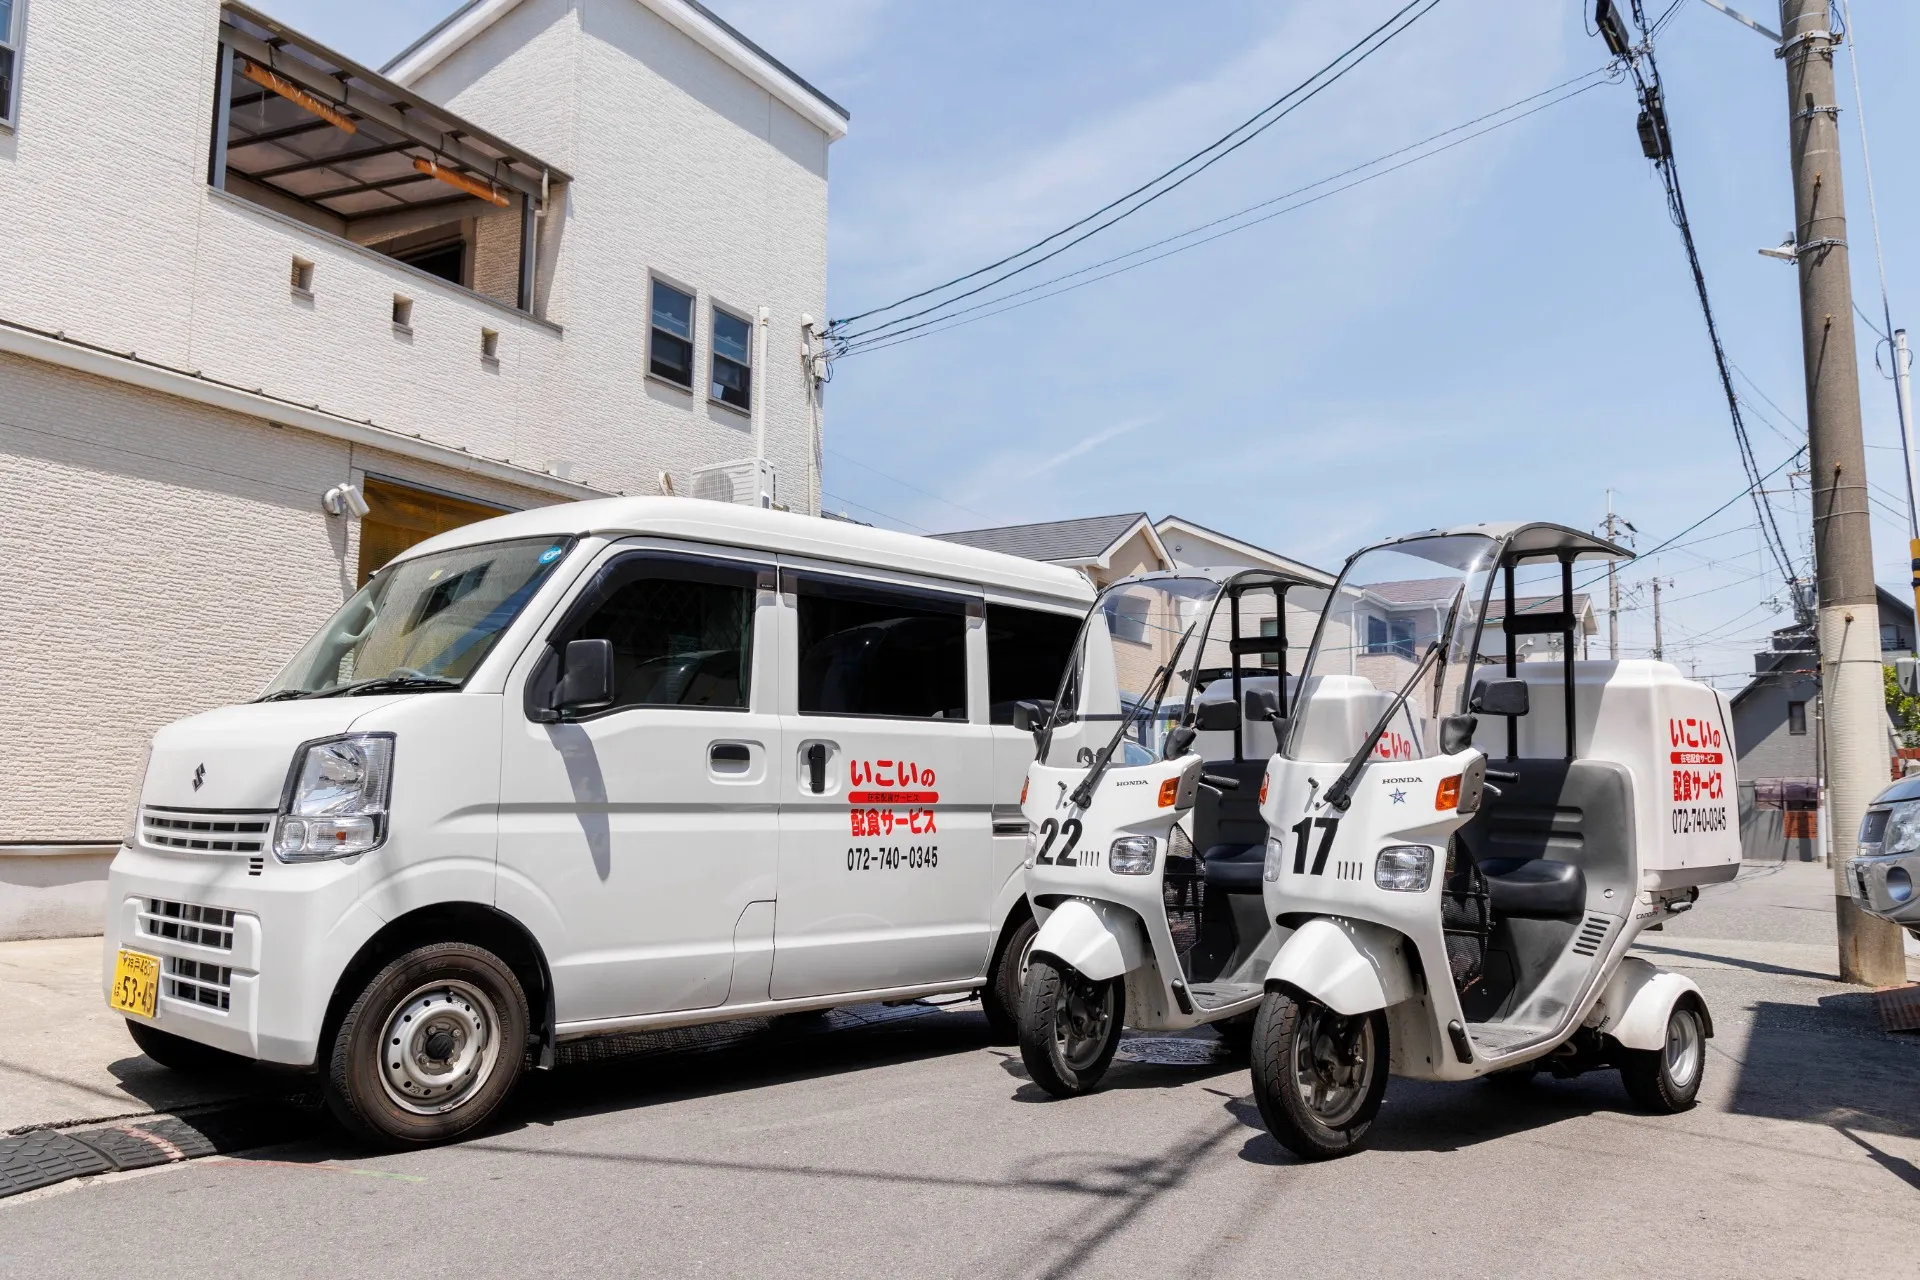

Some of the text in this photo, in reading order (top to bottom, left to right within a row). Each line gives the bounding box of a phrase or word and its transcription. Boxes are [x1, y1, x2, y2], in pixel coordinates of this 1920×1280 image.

[1669, 718, 1721, 748] いこいの
[850, 759, 936, 787] いこいの
[1672, 769, 1724, 801] 配食サービス
[850, 806, 937, 837] 配食サービス
[1672, 807, 1726, 834] 072-740-0345
[1036, 817, 1083, 867] 22
[1291, 817, 1340, 876] 17
[847, 846, 938, 871] 072-740-0345
